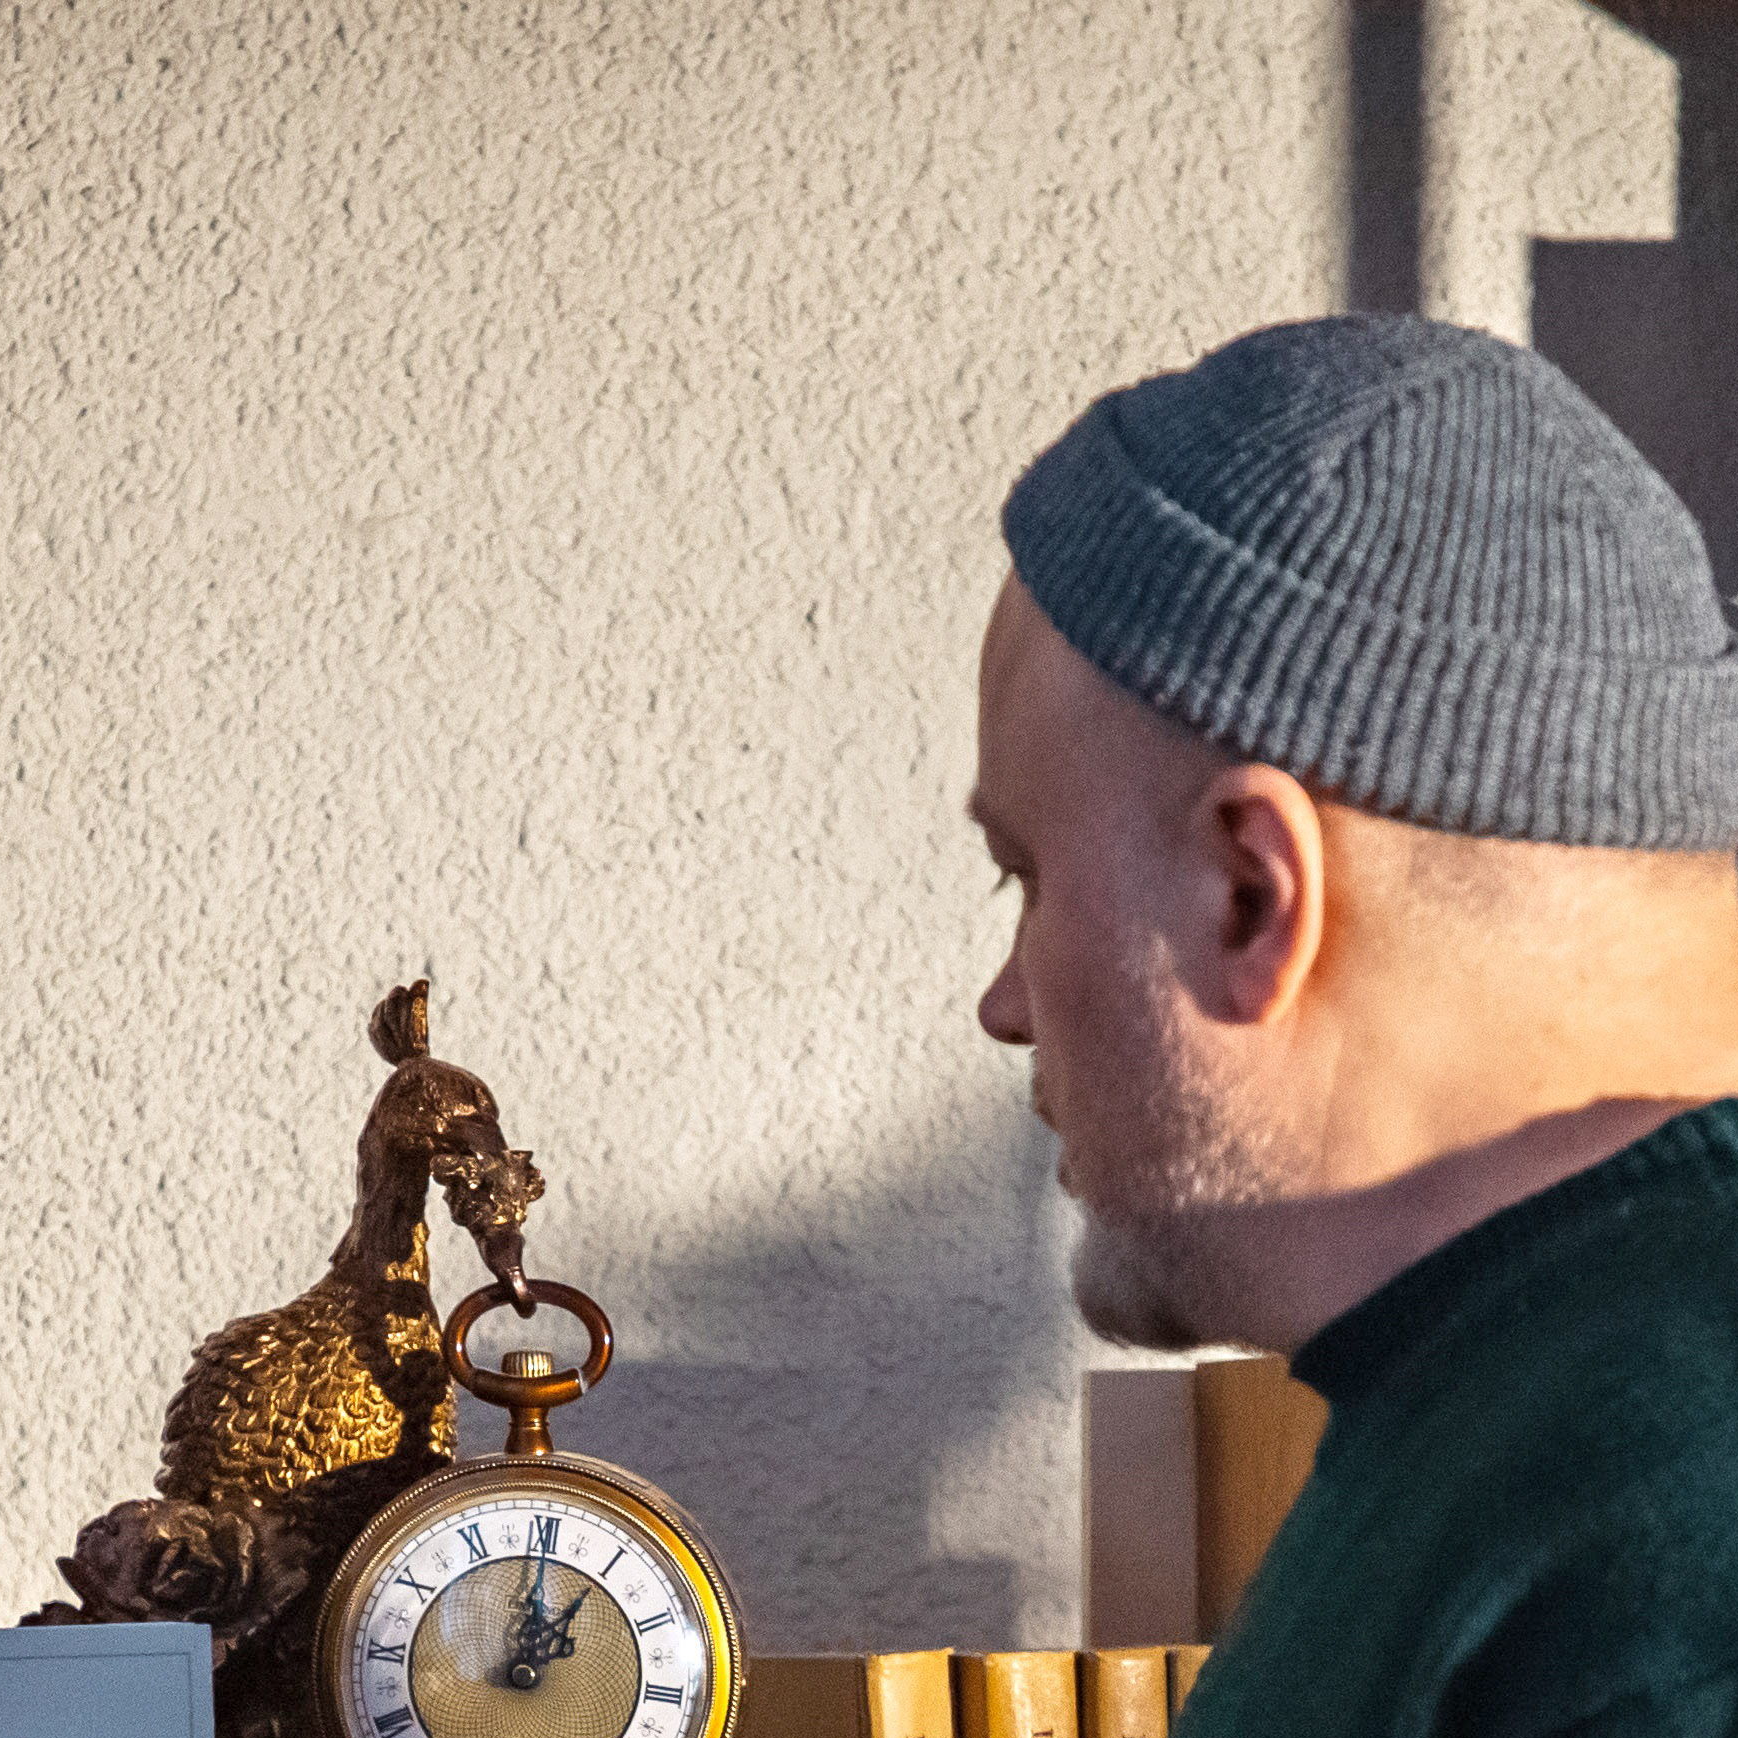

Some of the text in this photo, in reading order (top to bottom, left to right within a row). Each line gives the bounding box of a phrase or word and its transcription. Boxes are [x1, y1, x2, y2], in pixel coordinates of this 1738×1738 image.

[457, 1522, 492, 1564] XI
[598, 1545, 628, 1579] I
[395, 1565, 437, 1604] X
[634, 1607, 675, 1637] II
[643, 1680, 684, 1709] III
